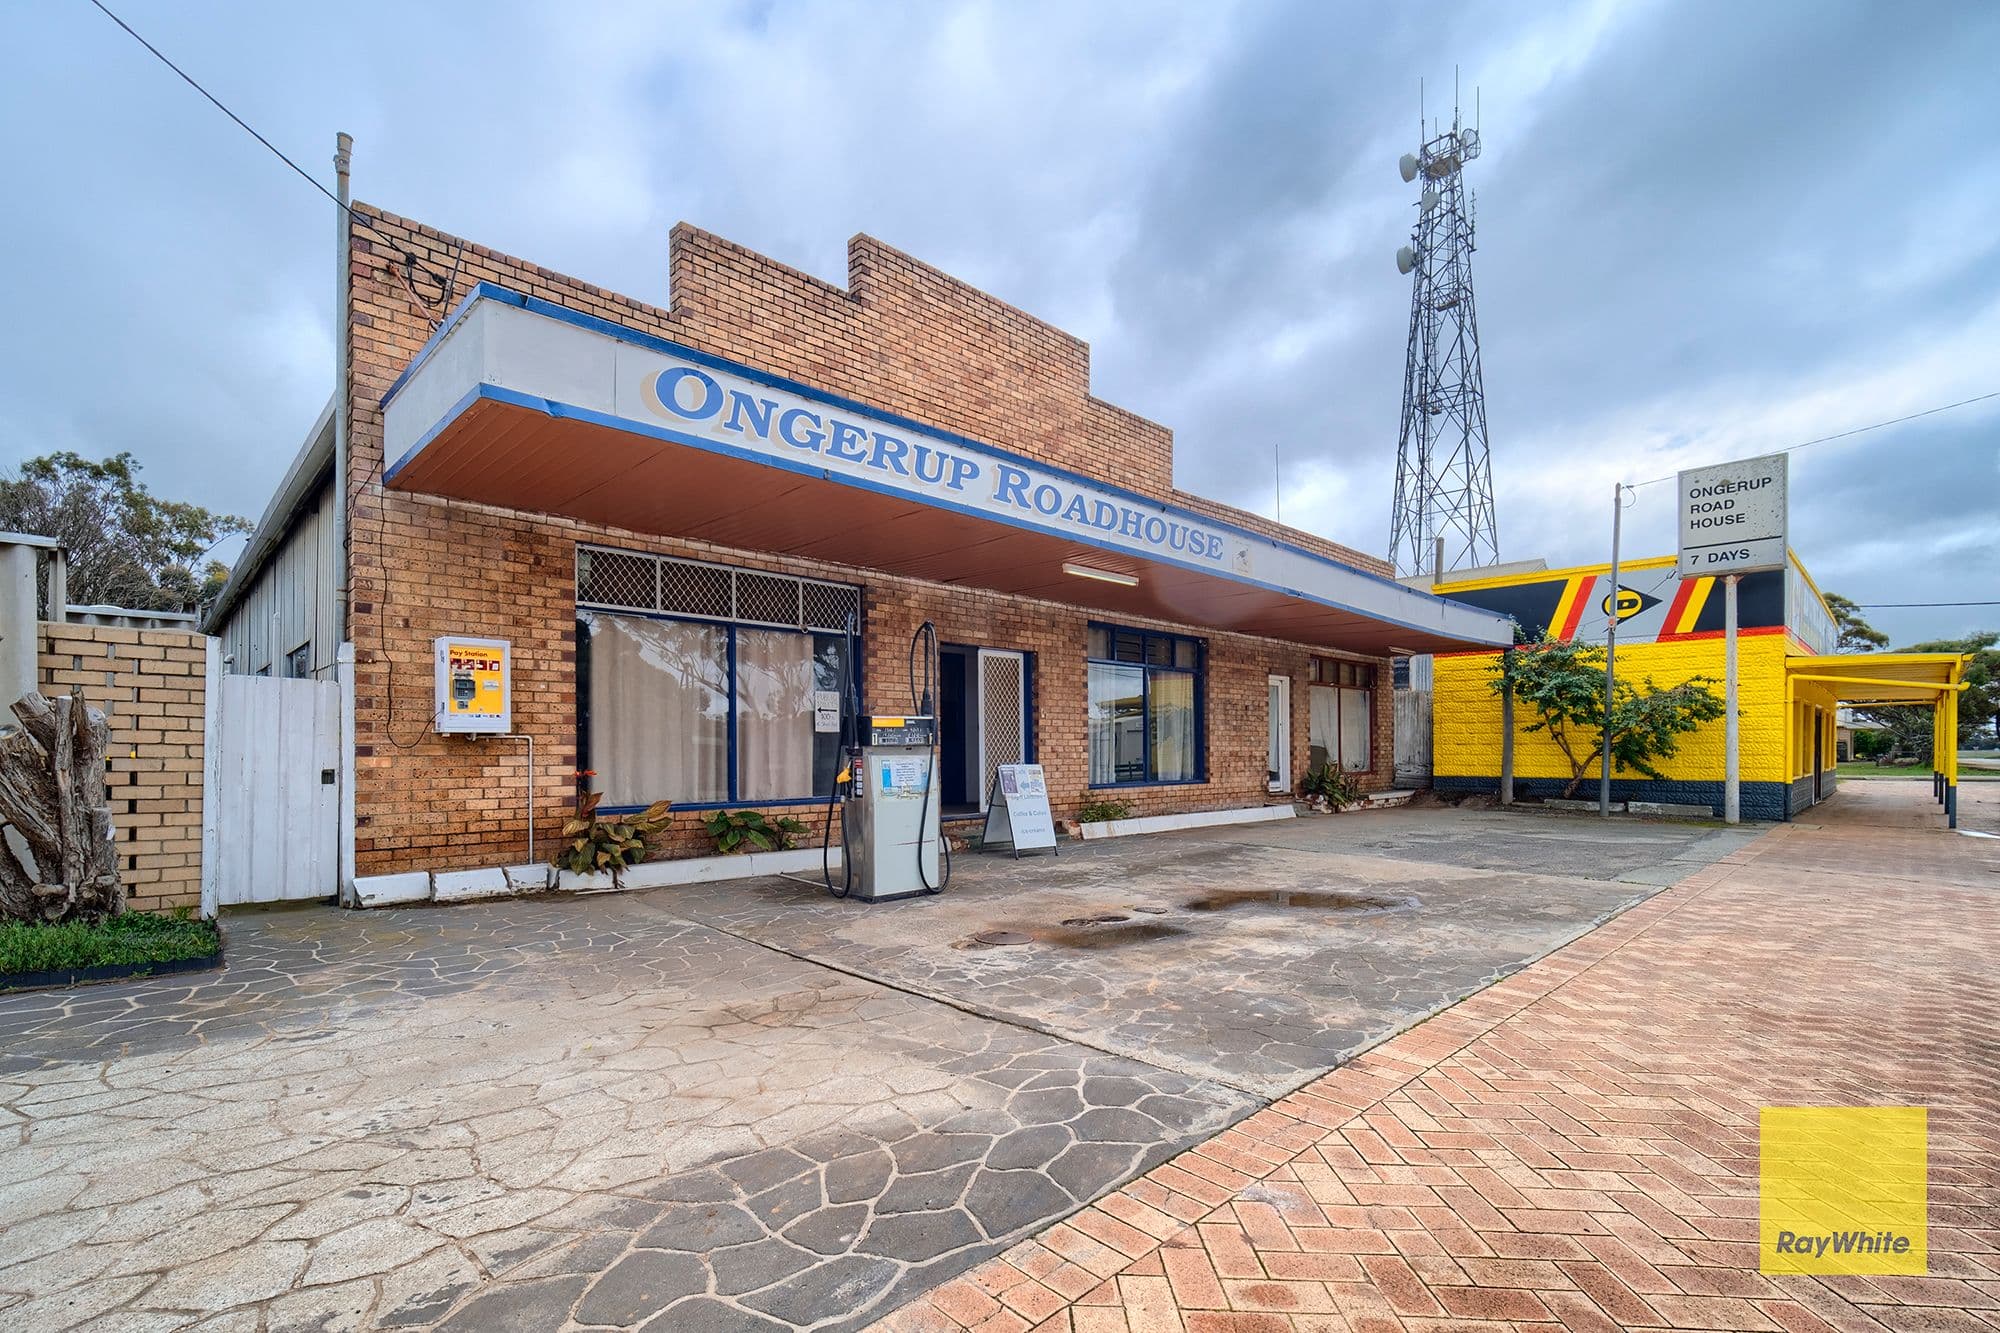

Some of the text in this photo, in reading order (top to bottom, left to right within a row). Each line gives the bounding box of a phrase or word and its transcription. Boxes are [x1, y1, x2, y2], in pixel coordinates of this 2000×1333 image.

[654, 366, 1224, 561] ONGERUP ROADHOUSE
[1689, 477, 1772, 499] ONGERUP
[1690, 499, 1735, 515] ROAD
[1690, 513, 1746, 530] HOUSE
[1691, 548, 1750, 565] 7 DAYS
[450, 649, 463, 658] Pay
[464, 650, 488, 658] Station
